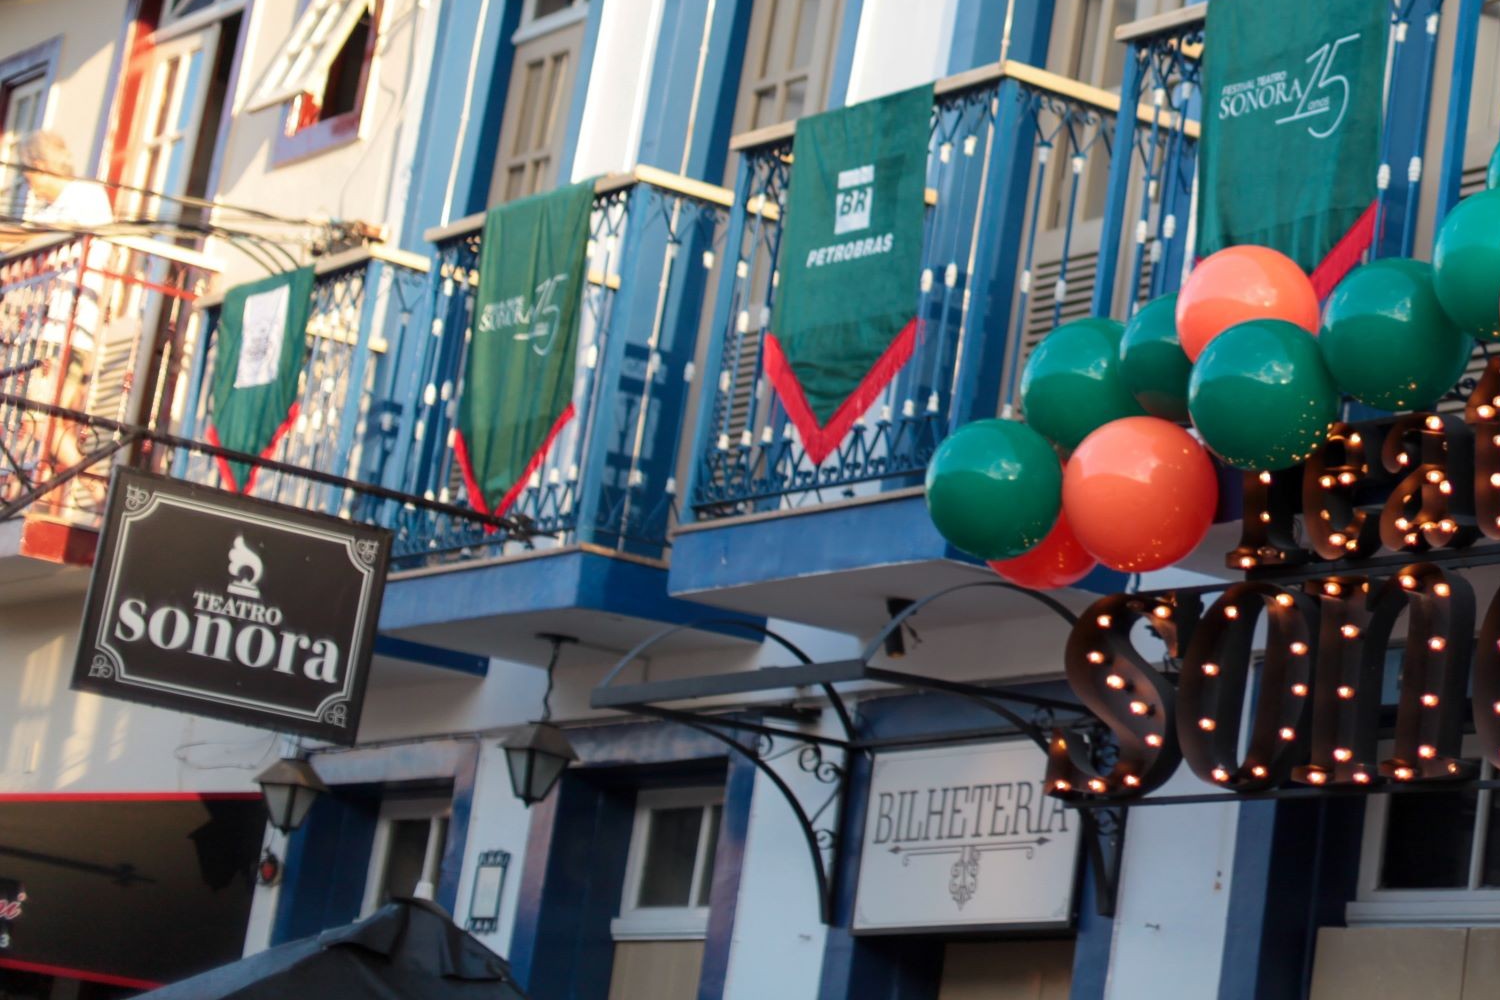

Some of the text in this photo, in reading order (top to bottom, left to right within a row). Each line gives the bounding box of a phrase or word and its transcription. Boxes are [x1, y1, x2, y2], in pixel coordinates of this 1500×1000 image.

[1218, 77, 1303, 120] SONORA
[805, 232, 894, 269] PETROBRAS
[192, 590, 284, 627] TEATRO
[113, 597, 341, 684] sonora
[872, 779, 1069, 845] BILHETERIA
